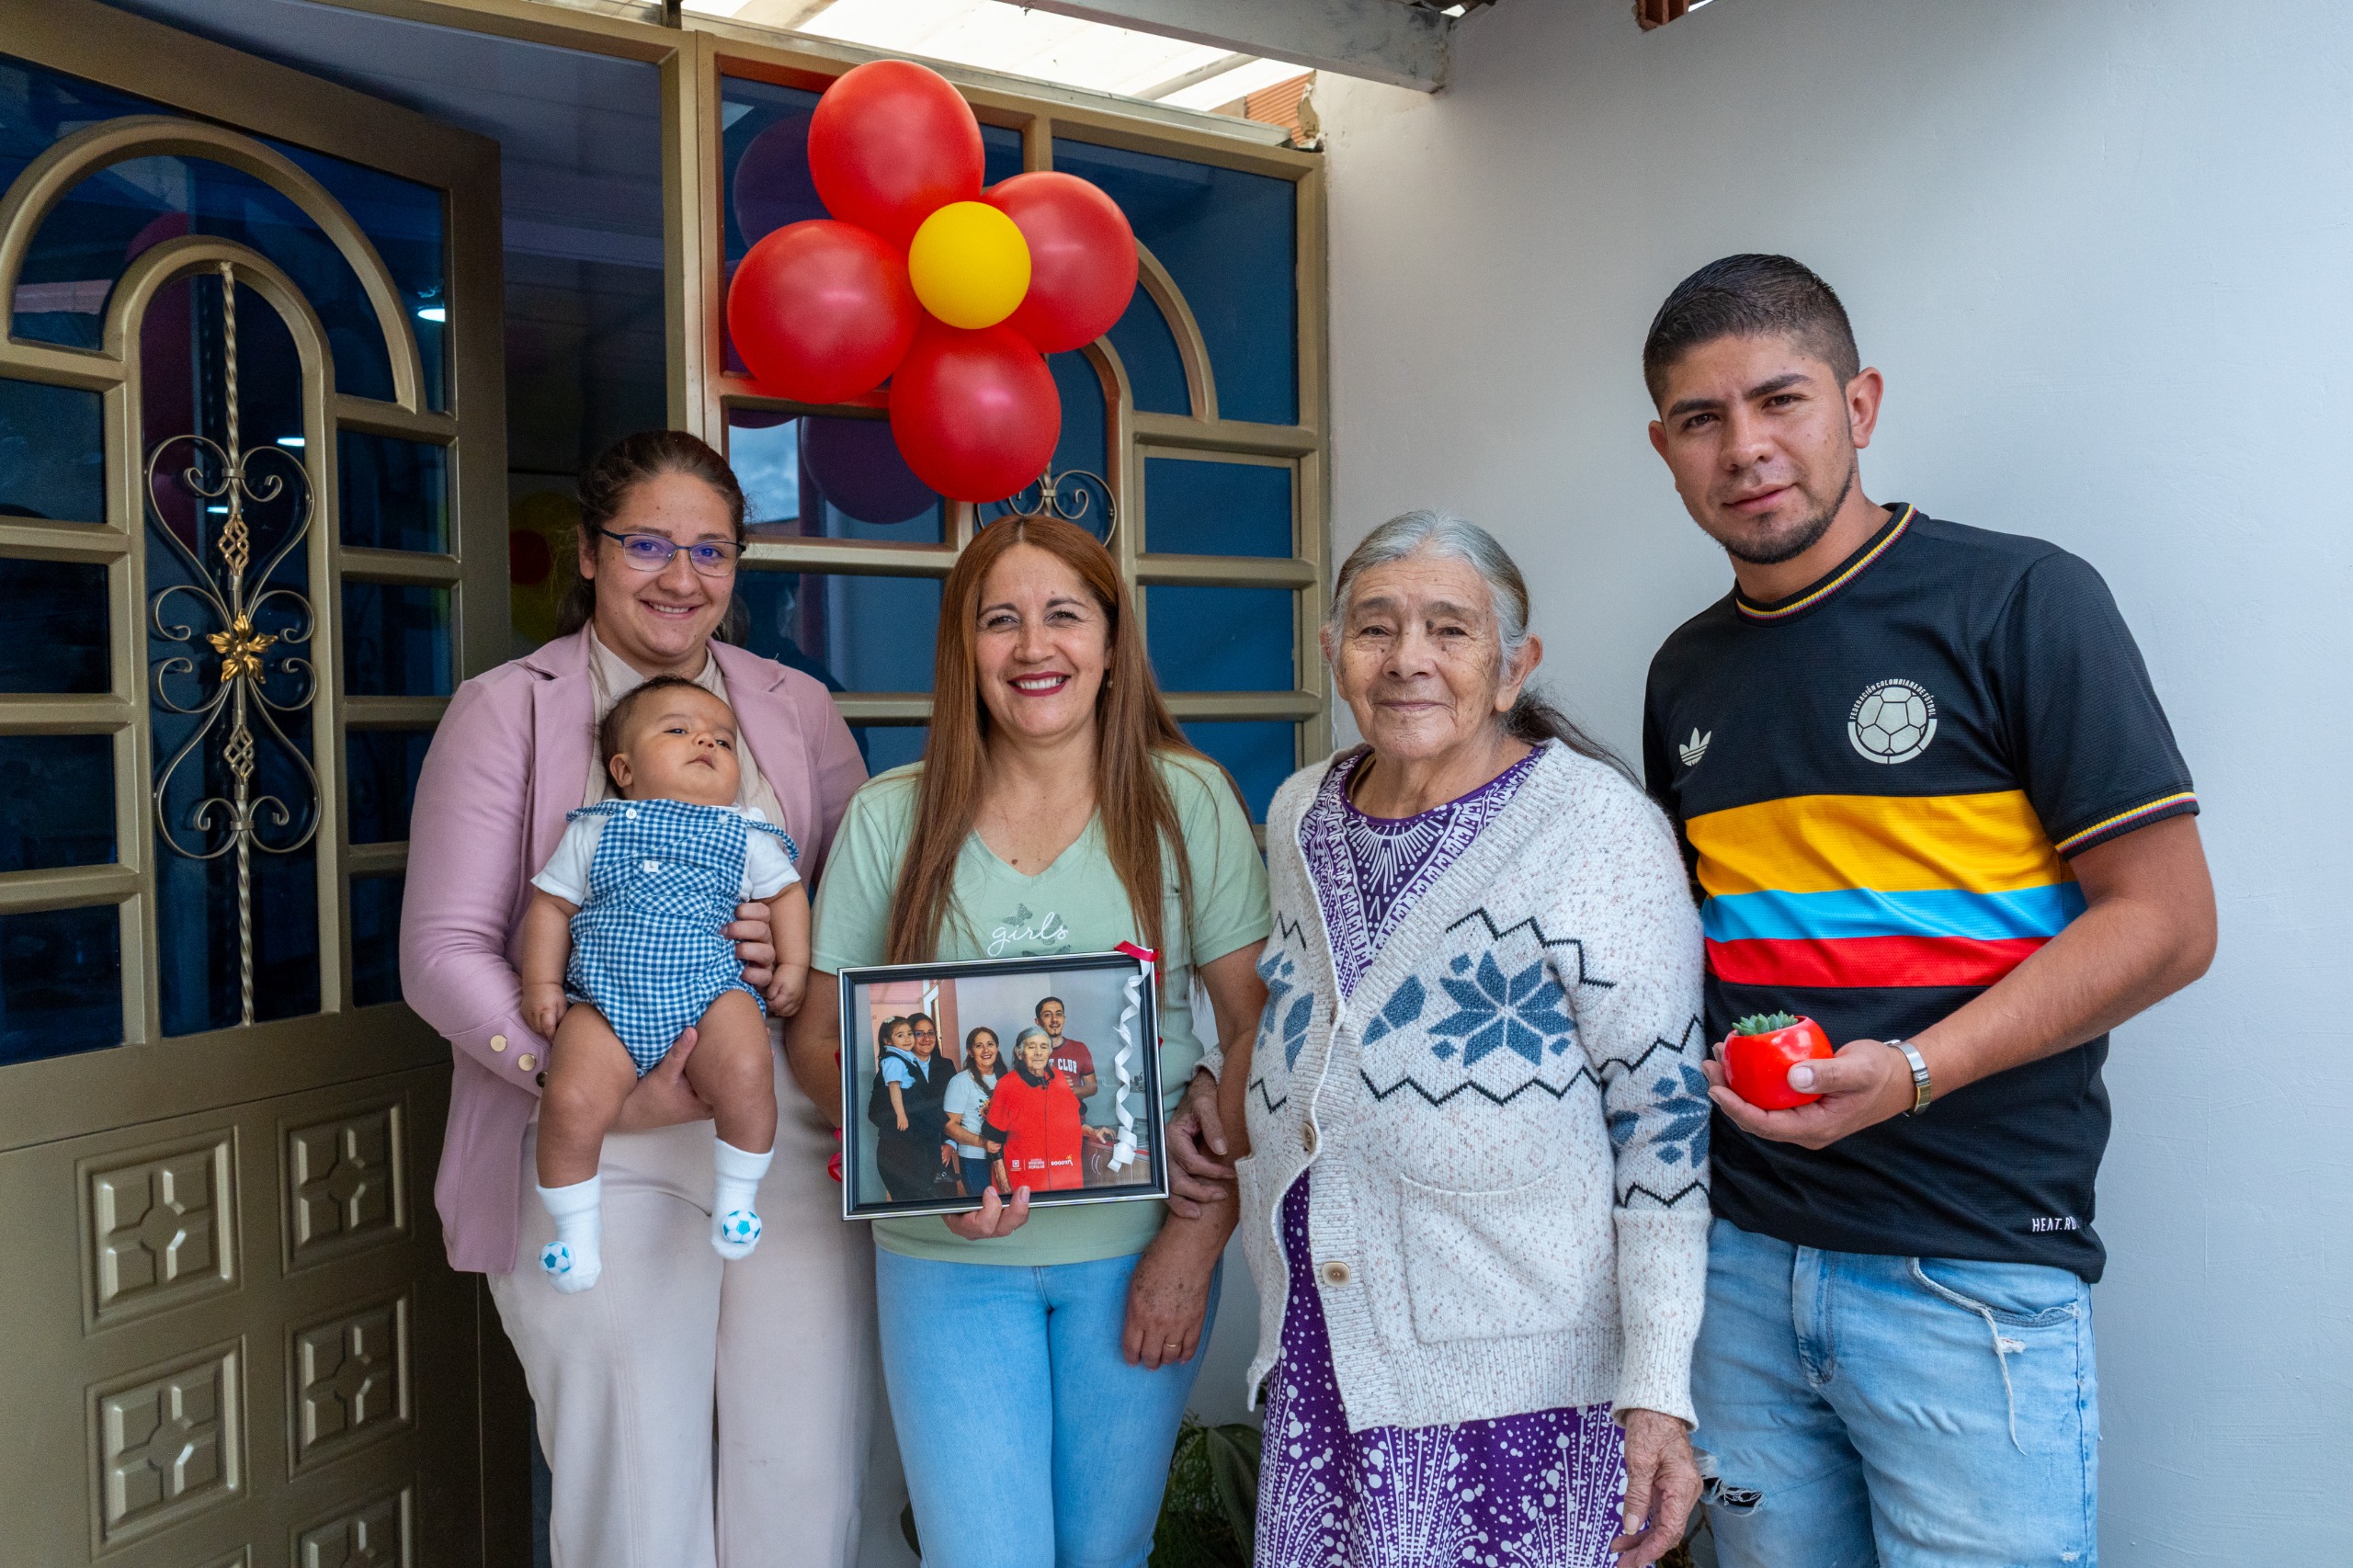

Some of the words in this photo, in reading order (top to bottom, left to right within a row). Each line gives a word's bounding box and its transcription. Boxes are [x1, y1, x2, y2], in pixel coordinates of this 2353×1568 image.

[1849, 685, 1876, 720] FEDERACIÓN
[1876, 678, 1919, 690] COLOMBIANA
[1915, 687, 1926, 696] DE
[1922, 693, 1937, 717] FÚTBOL
[987, 912, 1068, 957] girls
